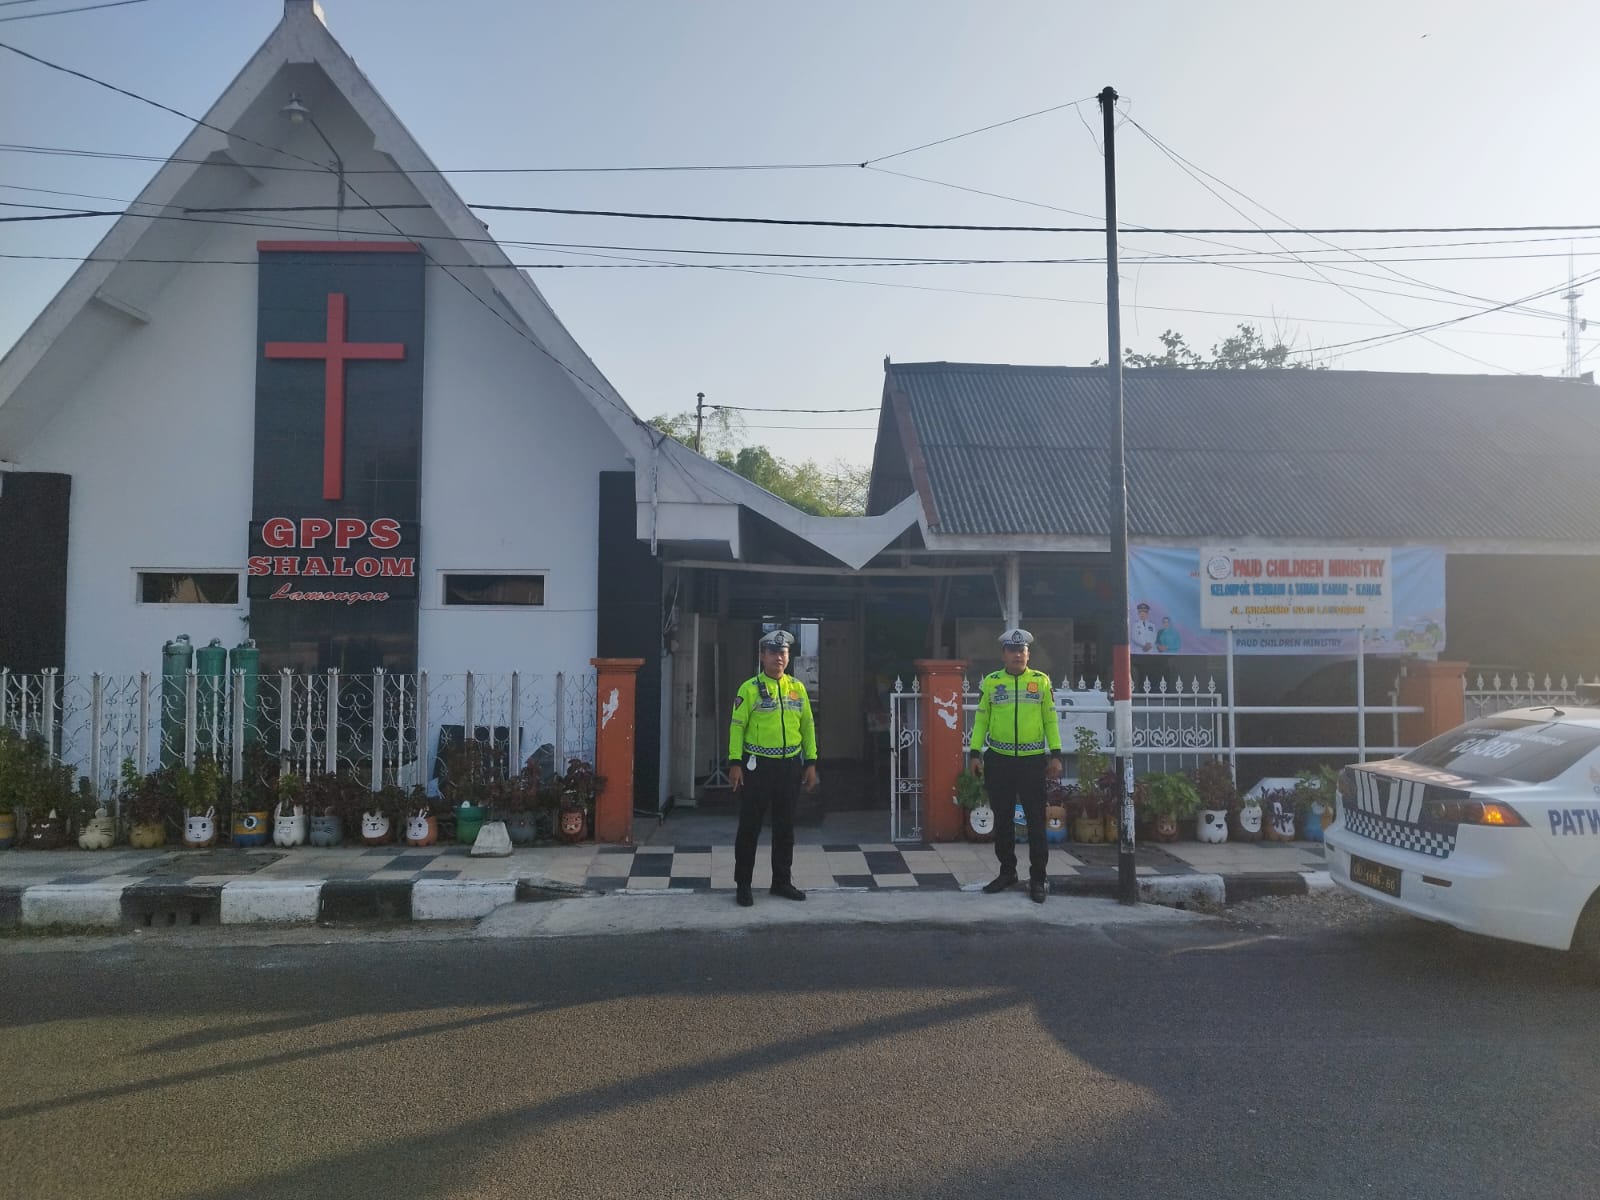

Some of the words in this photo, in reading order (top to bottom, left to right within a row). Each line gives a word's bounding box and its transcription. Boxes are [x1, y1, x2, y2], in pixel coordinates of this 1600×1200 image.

[262, 517, 401, 549] GPPS
[247, 556, 415, 577] SHALOM
[1233, 559, 1262, 577] PAUD
[1266, 559, 1324, 577] CHILDREN
[1328, 559, 1385, 577] MINISTRY
[270, 583, 390, 604] Lamongan
[1236, 638, 1258, 648] PAUD
[1260, 638, 1300, 649] CHILDREN
[1303, 638, 1343, 648] MINISTRY
